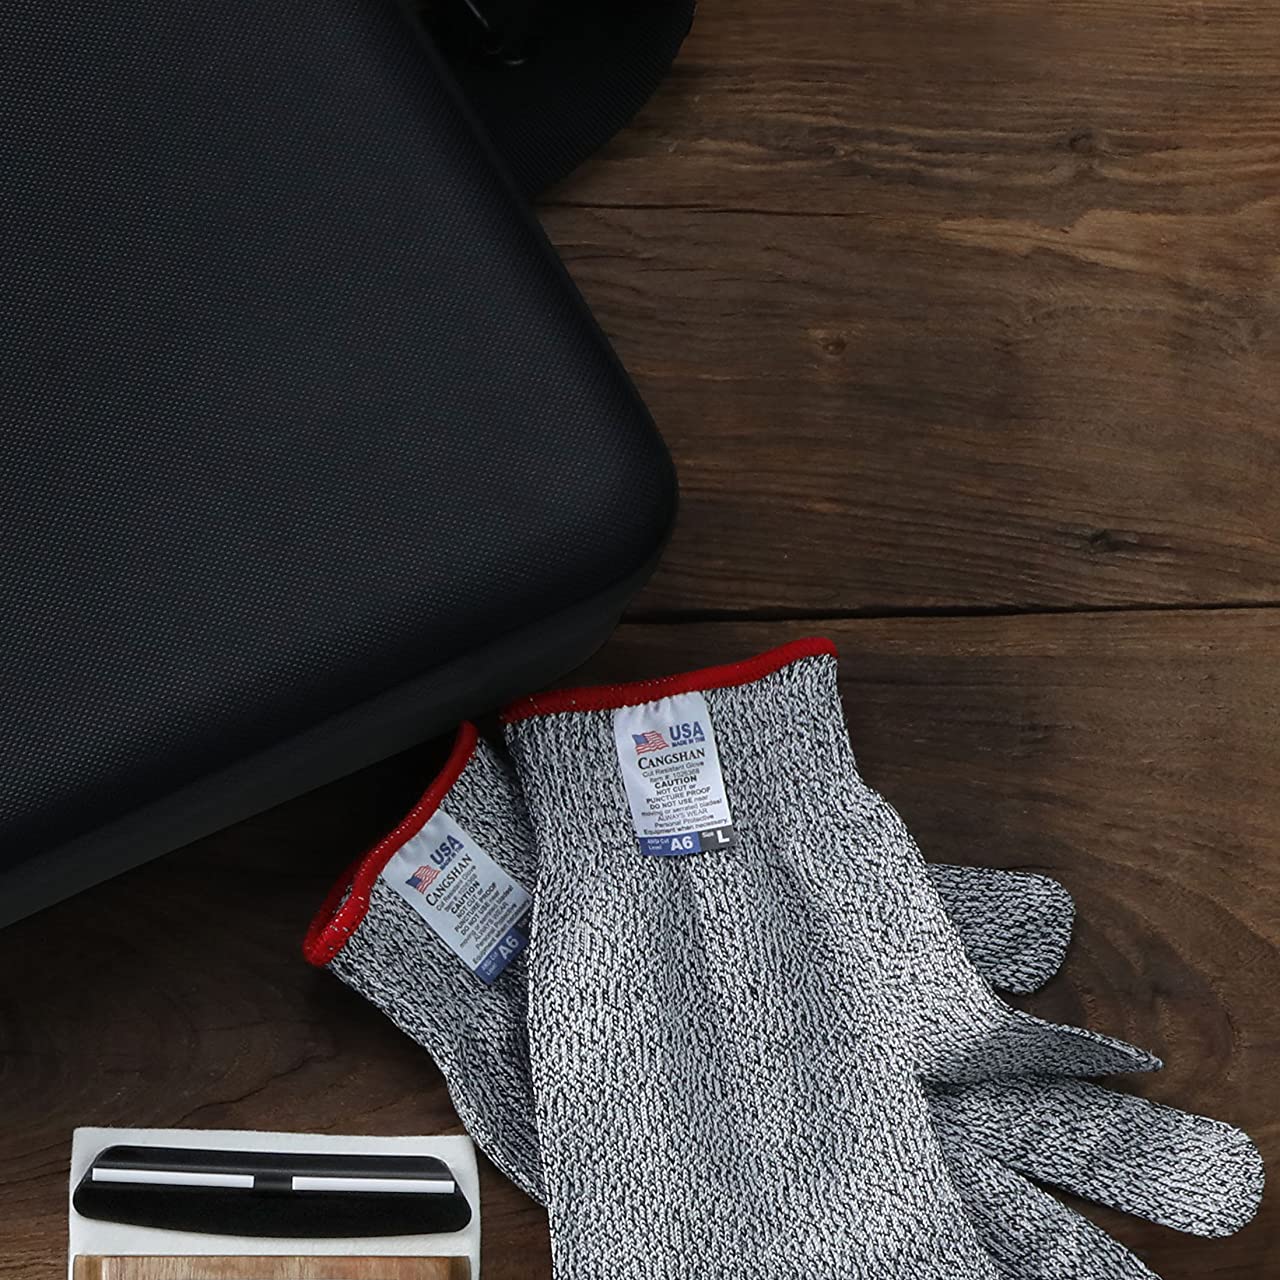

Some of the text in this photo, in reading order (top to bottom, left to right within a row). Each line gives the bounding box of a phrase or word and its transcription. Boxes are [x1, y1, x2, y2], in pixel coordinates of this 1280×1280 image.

[669, 721, 704, 741] USA
[638, 748, 705, 770] CANGSHAN
[655, 775, 697, 789] CAUTION
[656, 788, 671, 796] NOT
[673, 785, 687, 793] CUT
[646, 786, 711, 804] PUNCTURE PROOF
[658, 808, 708, 822] ALWAYS WEAR
[671, 836, 693, 851] A6
[716, 830, 730, 843] L
[430, 835, 459, 865] USA
[426, 853, 472, 906] CANGSHAN
[451, 880, 480, 914] CAUTION
[454, 901, 481, 932] PUNCTURE
[479, 882, 496, 902] PROOF
[456, 905, 468, 919] NOT
[466, 894, 478, 907] CUT
[461, 925, 470, 935] DO
[468, 913, 480, 926] NOT
[498, 936, 519, 959] A6
